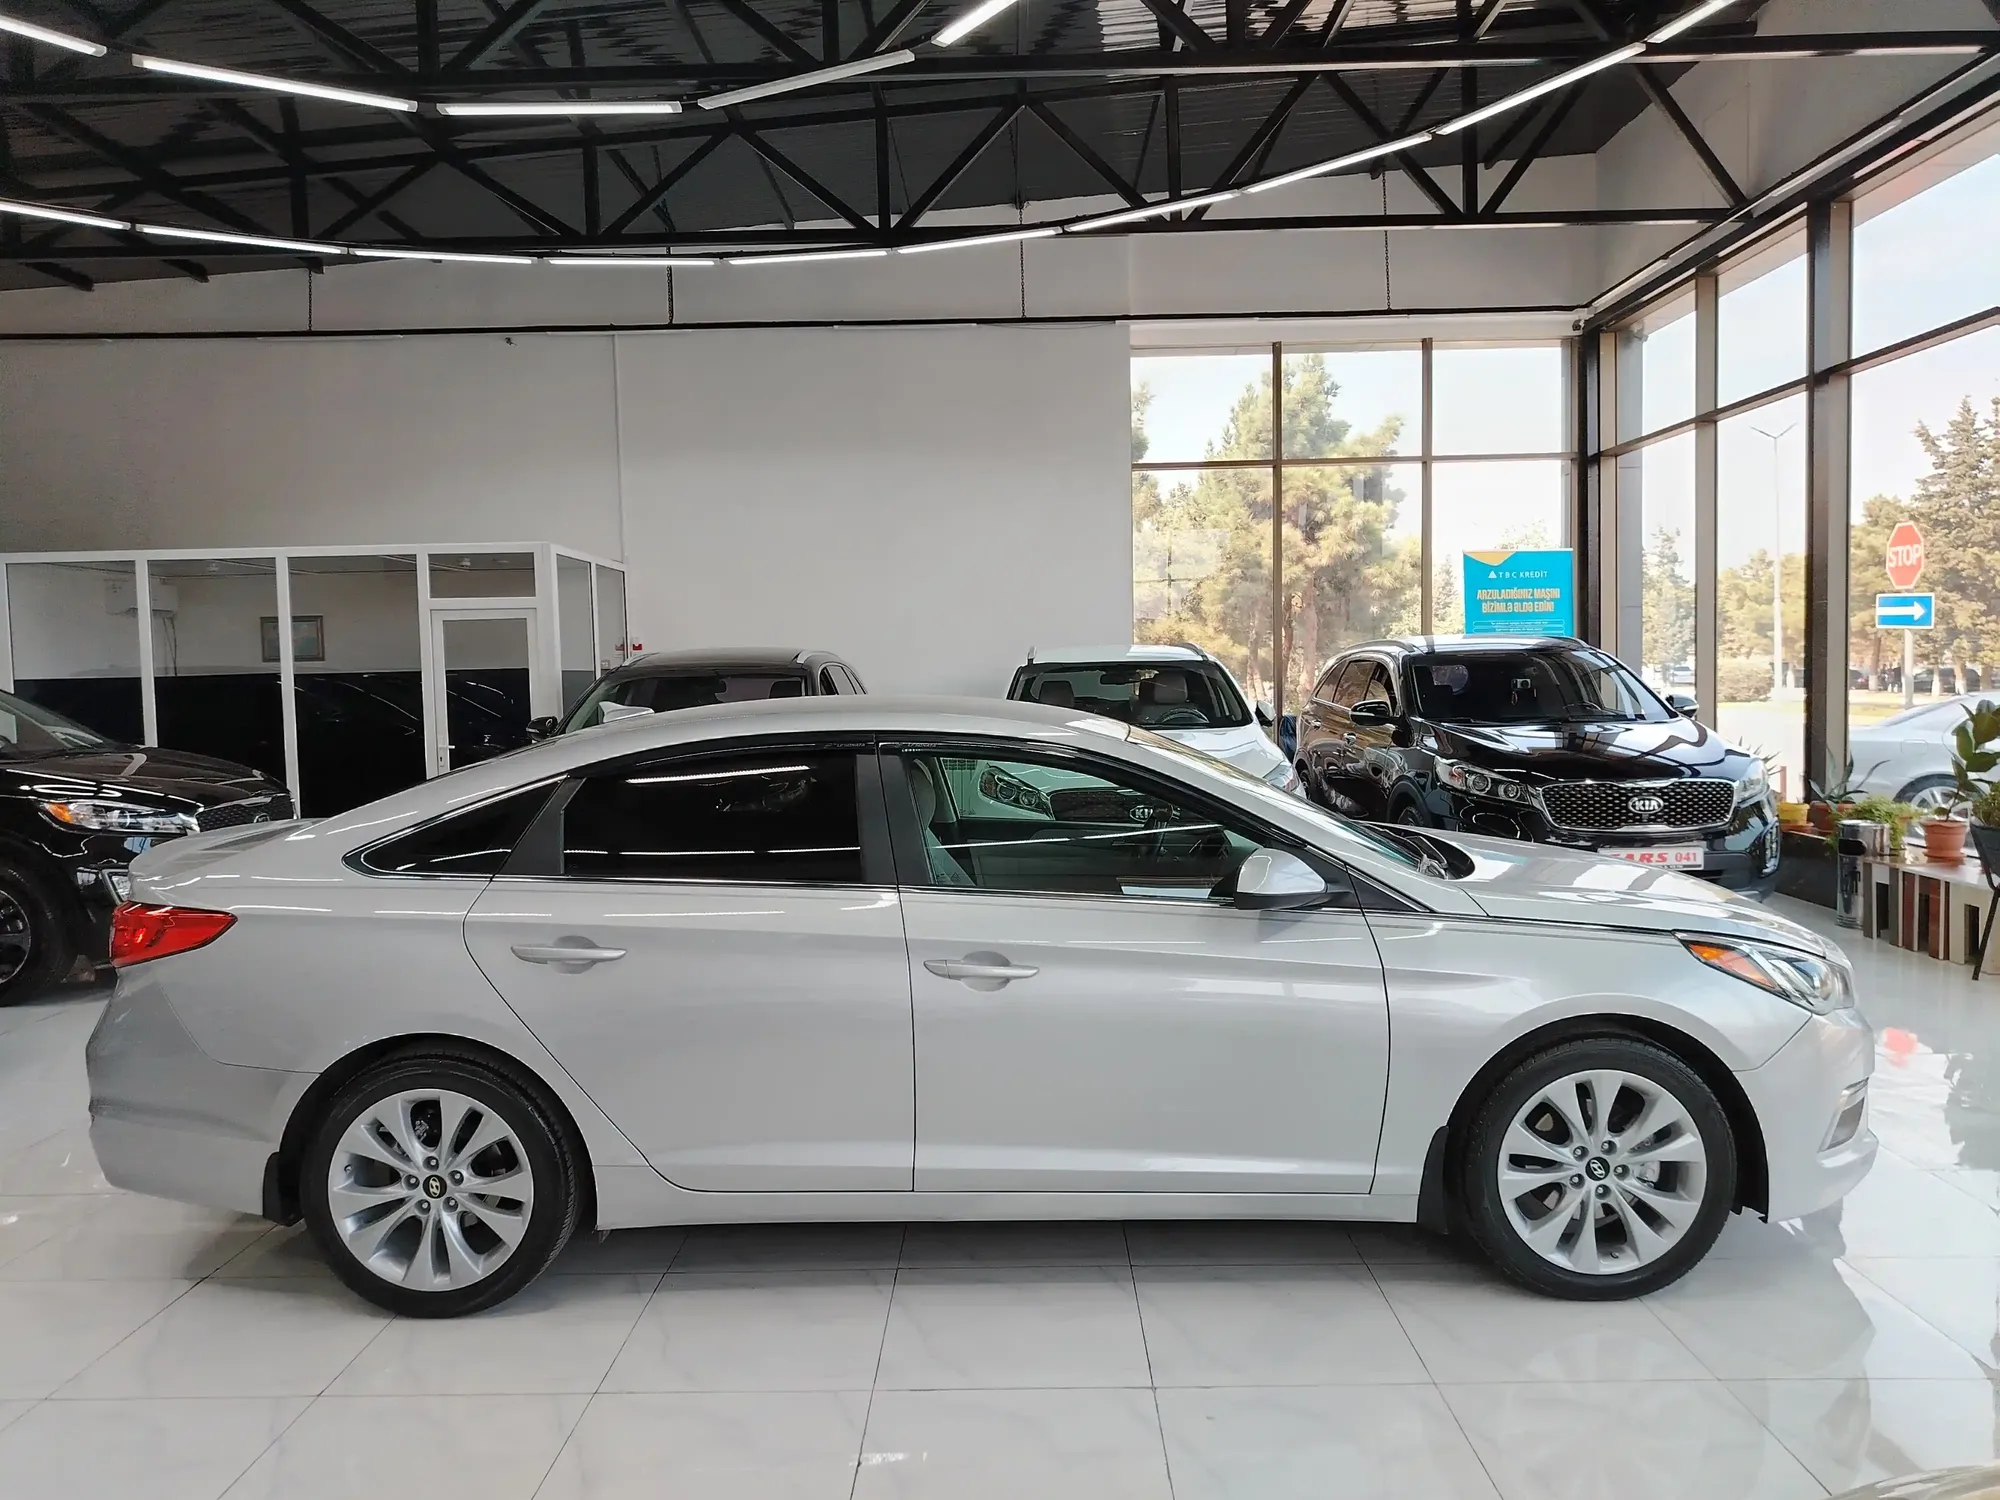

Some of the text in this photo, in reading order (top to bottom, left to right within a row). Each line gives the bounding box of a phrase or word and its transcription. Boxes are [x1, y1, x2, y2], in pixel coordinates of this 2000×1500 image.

[1888, 544, 1921, 568] STOP
[1635, 800, 1660, 811] KIA
[1612, 852, 1697, 864] ARS 041
